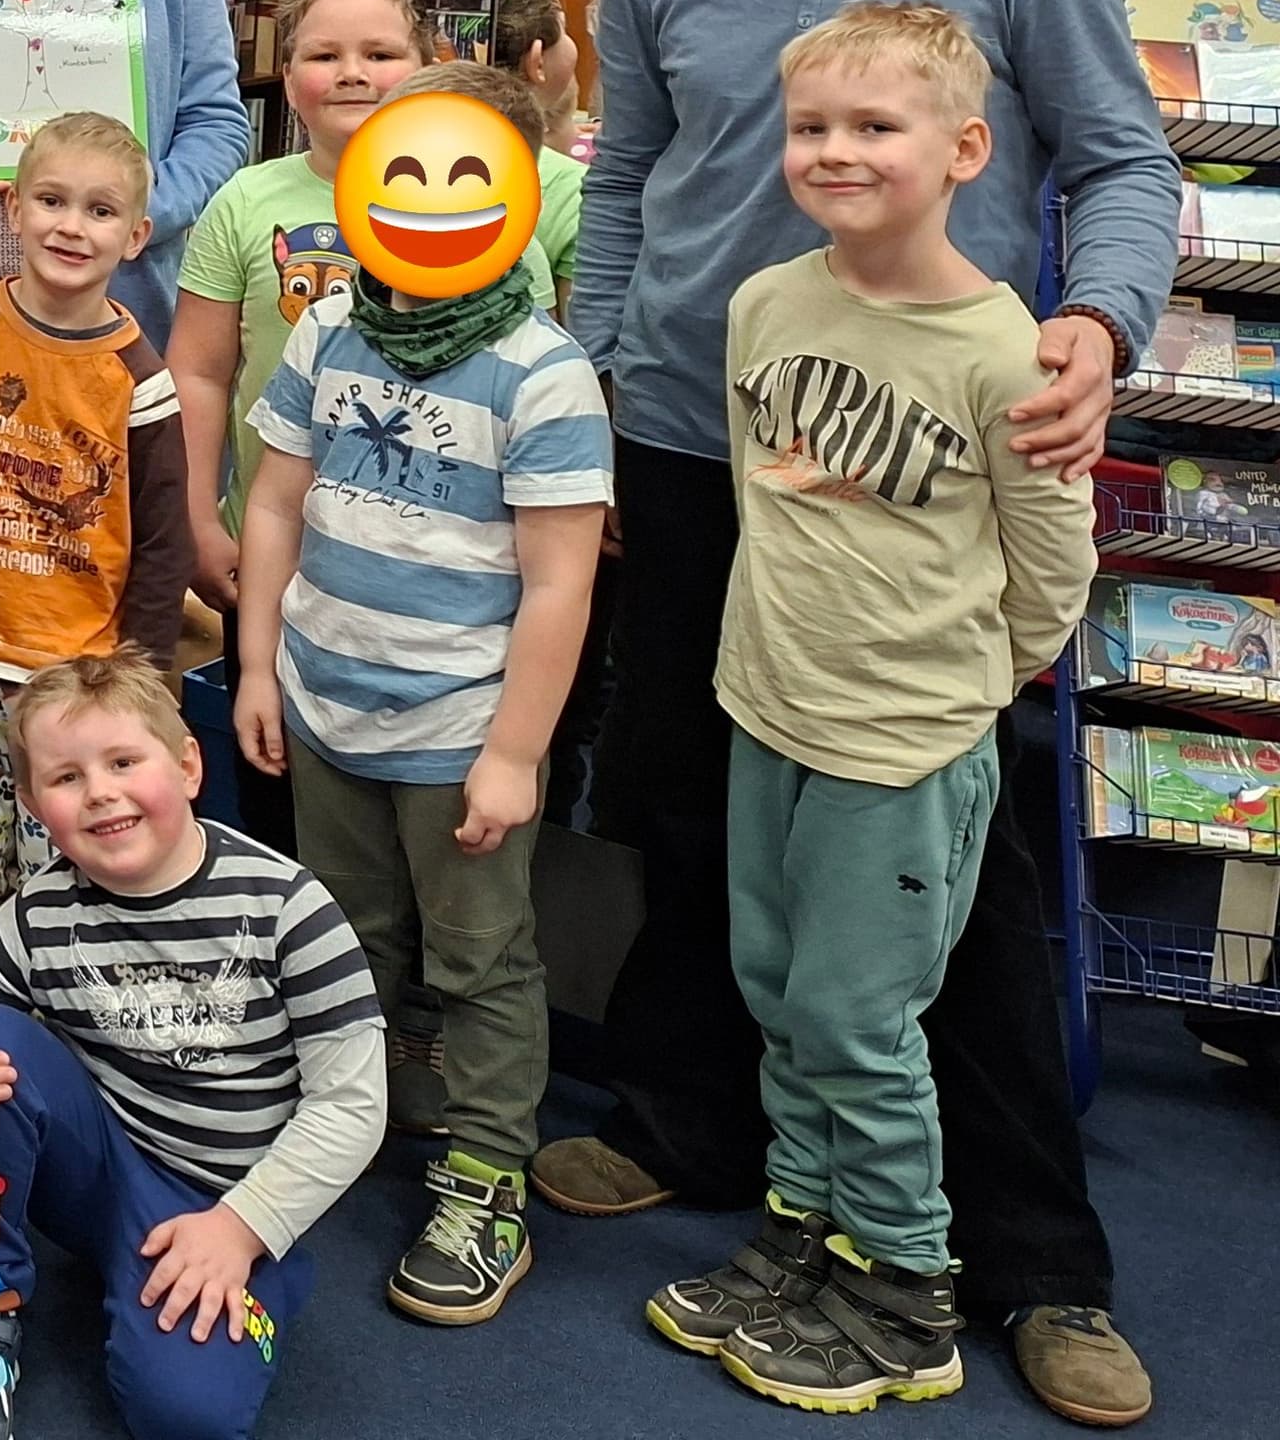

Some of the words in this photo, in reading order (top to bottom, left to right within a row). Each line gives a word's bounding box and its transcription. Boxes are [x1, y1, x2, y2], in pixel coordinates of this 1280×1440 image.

[382, 380, 460, 473] SHAHOLA
[432, 482, 452, 501] 91
[1246, 492, 1270, 507] BETT
